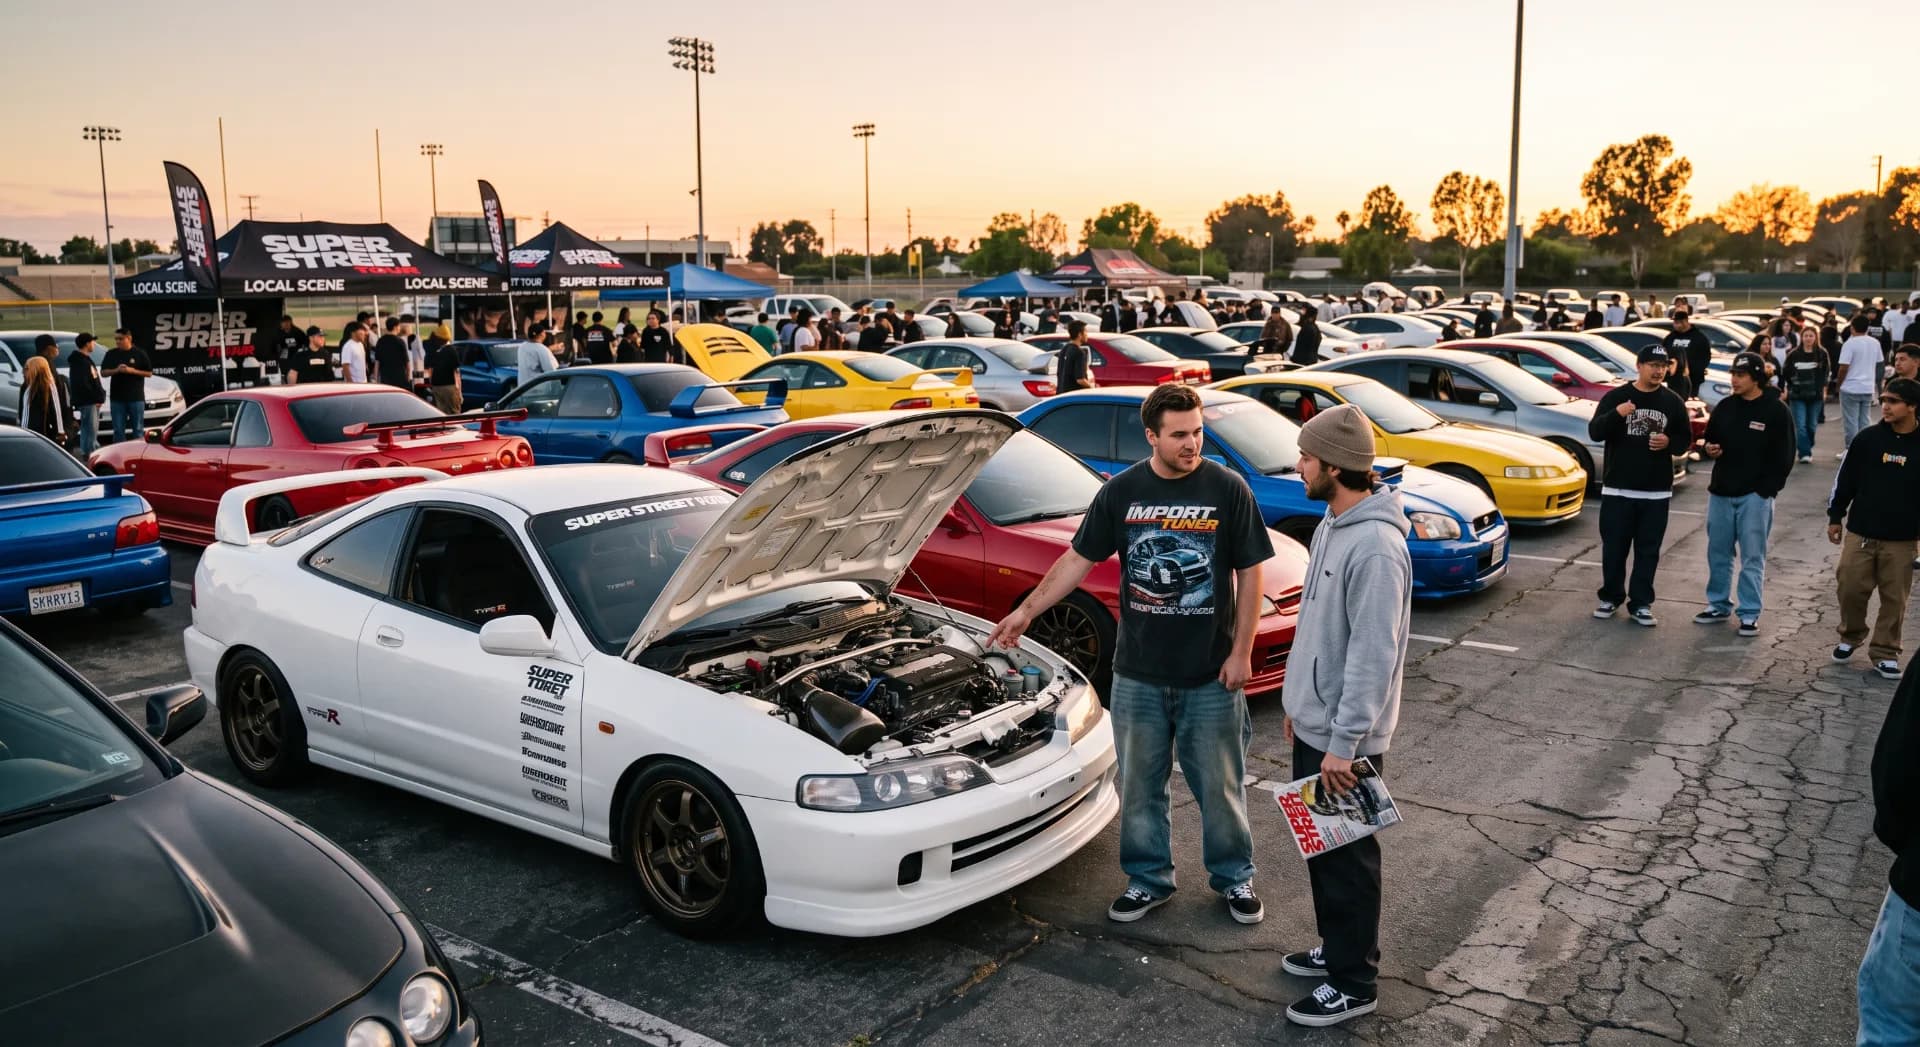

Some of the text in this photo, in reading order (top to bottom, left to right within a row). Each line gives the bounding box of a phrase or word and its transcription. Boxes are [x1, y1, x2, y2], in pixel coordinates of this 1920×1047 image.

[261, 234, 394, 253] SUPER
[271, 251, 413, 269] STREET
[133, 281, 197, 294] LOCAL SCENE
[244, 279, 345, 293] LOCAL SCENE
[405, 278, 447, 290] LOCAL
[448, 277, 488, 289] SCENE
[520, 277, 543, 287] TOUR
[559, 276, 663, 287] SUPER STREET TOUR
[155, 311, 248, 332] SUPER
[154, 327, 257, 350] STREET
[564, 508, 633, 531] SUPER
[634, 497, 695, 516] STREET
[1126, 505, 1217, 520] IMPORT
[1161, 519, 1219, 530] TUNER
[474, 606, 496, 614] TYPE
[526, 664, 574, 685] SUPER
[327, 708, 341, 726] R
[1277, 794, 1309, 855] SUPER
